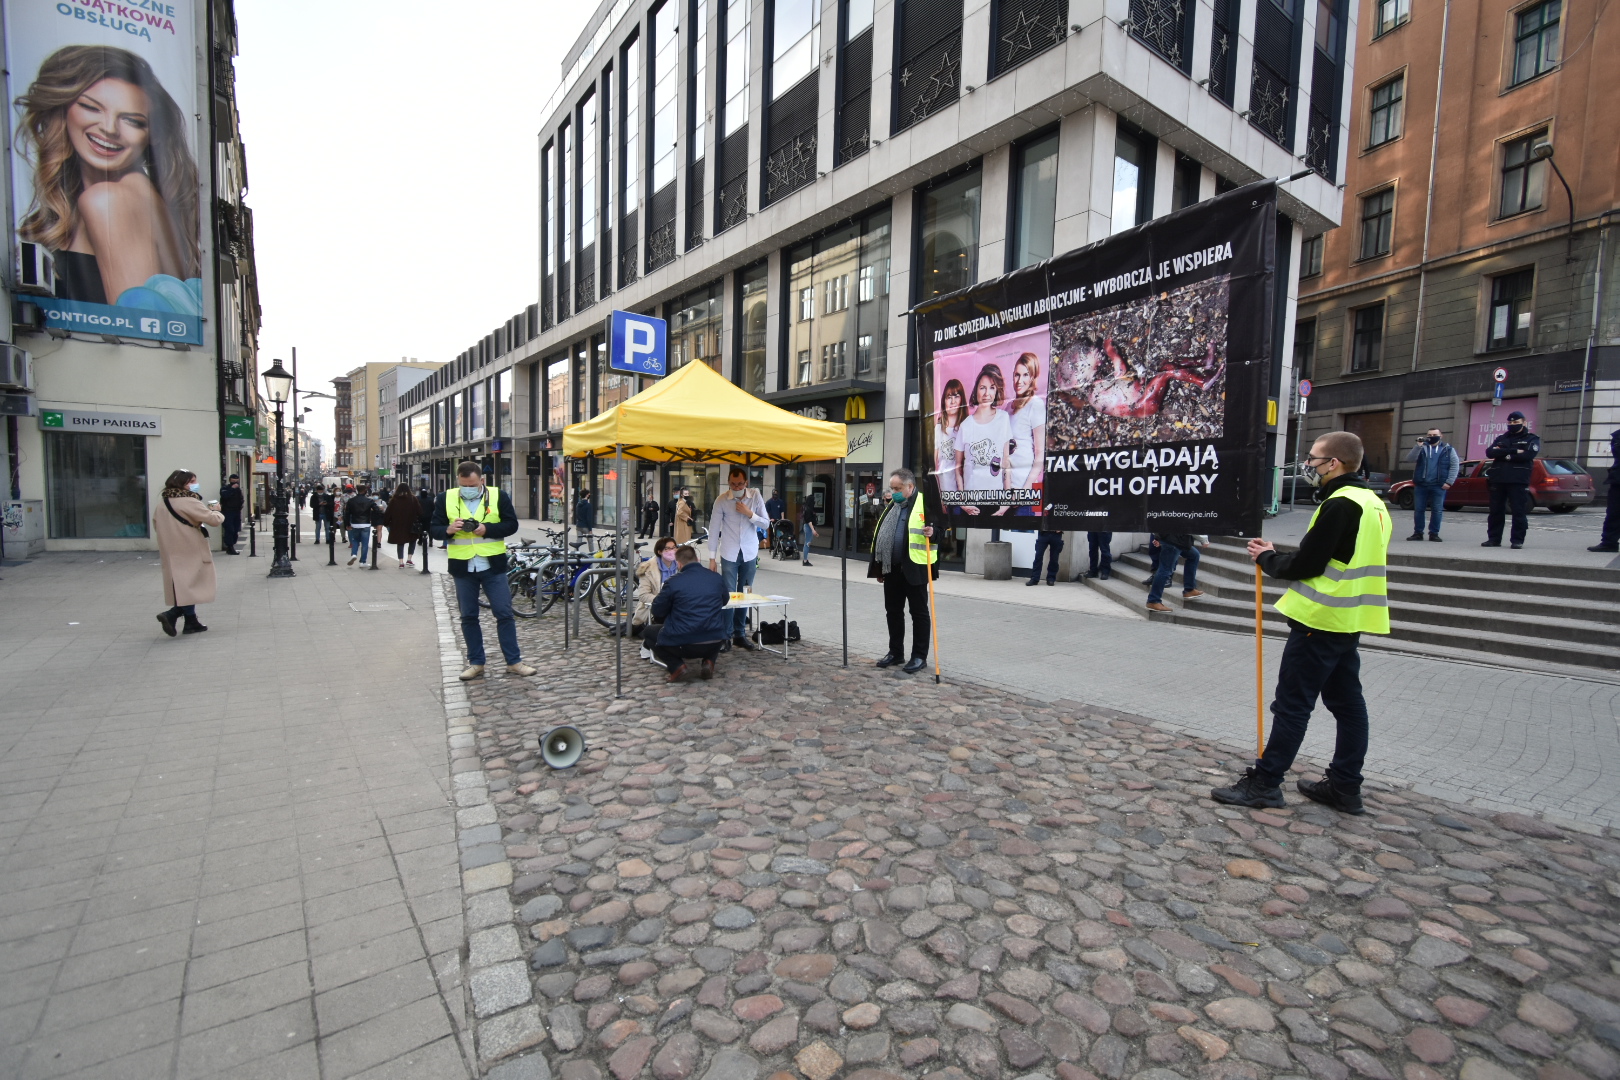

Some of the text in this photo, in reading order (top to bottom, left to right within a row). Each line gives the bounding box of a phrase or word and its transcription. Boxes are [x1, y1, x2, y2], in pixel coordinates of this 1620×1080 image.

[56, 2, 151, 42] OBSŁUGĄ
[933, 241, 1233, 343] TO ONE SPRZEDAJĄ PIGUŁKI ABORCYJNE WYBORCZA JE WSPIERA
[624, 318, 656, 364] P
[72, 417, 157, 429] BNP PARIBAS
[1046, 444, 1219, 473] TAK WYGLĄDAJĄ
[979, 489, 1012, 500] KILLING
[1013, 489, 1041, 500] TEAM
[1088, 473, 1219, 496] ICH OFIARY
[1054, 503, 1069, 511] stop
